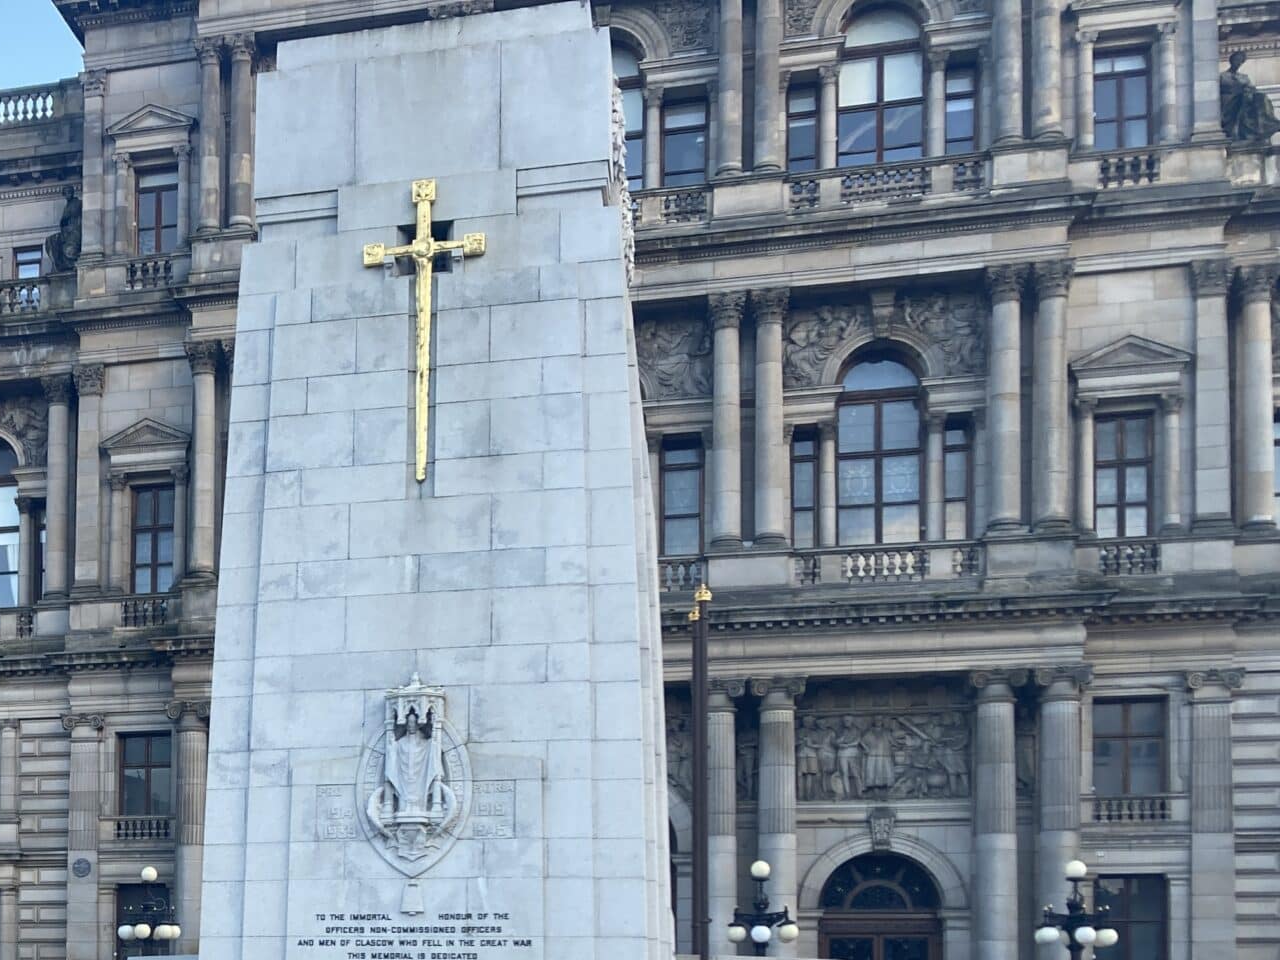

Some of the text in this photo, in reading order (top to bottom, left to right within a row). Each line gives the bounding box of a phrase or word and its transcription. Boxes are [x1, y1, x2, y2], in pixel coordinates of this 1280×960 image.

[316, 912, 509, 922] TO THE IMMORTAL HONOUR OF THE
[326, 925, 502, 934] OFFICERS NON-COMMISSIONED OFFICERS
[298, 938, 532, 948] AND MEN OF GLASGOW WHO FELL IN THE GREAT WAR
[348, 952, 477, 960] THIS MEMORIAL IS DEDICATED
